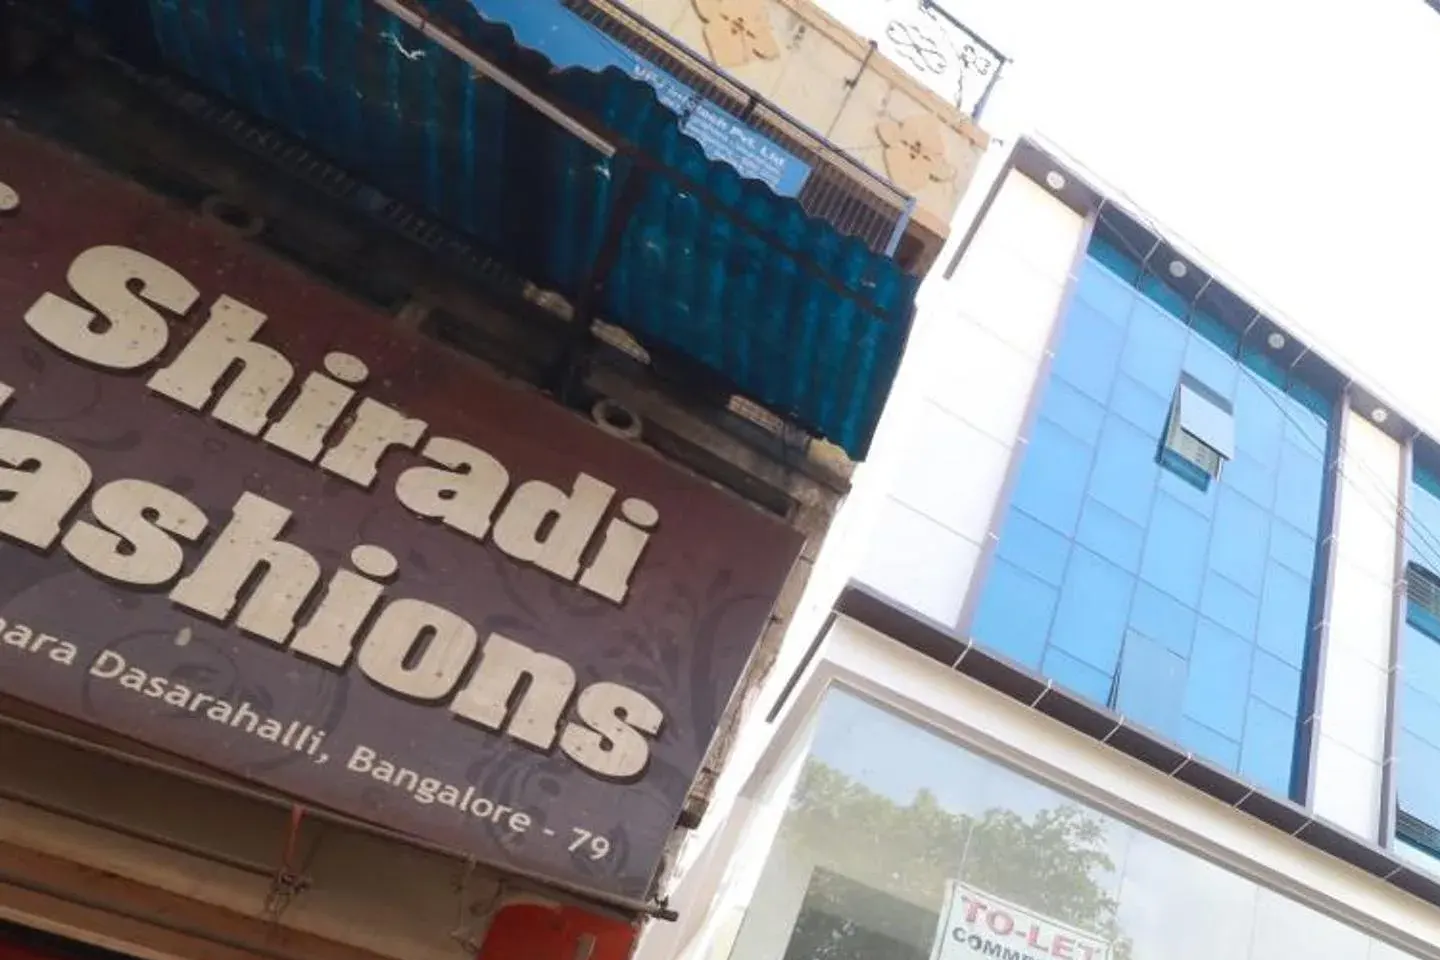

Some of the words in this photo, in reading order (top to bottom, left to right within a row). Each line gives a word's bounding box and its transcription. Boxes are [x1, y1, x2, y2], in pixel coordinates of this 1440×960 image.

[0, 382, 665, 780] ashions
[24, 244, 660, 600] Shiradi
[89, 649, 331, 765] Dasarahalli,
[348, 744, 532, 834] Bangalore
[568, 826, 612, 862] 79
